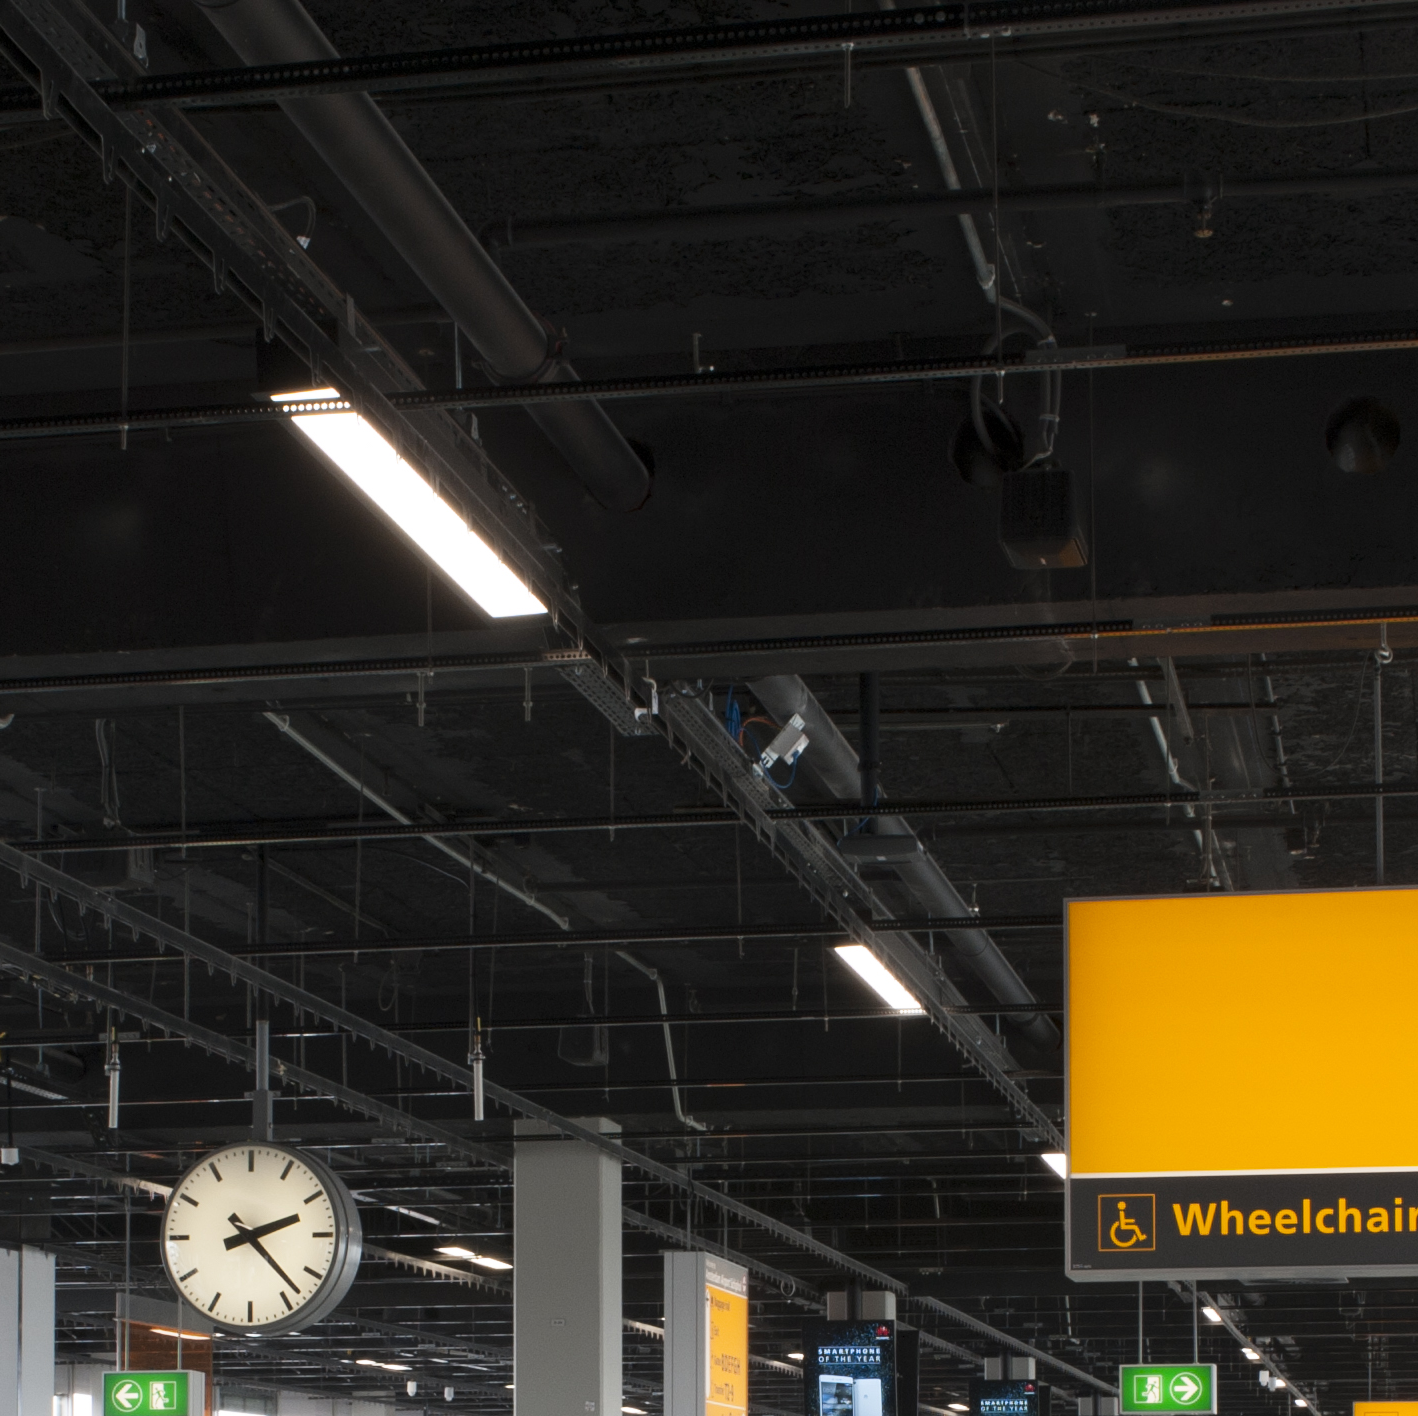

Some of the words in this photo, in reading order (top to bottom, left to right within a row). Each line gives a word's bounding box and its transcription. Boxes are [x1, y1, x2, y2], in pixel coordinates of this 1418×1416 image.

[818, 1355, 830, 1363] OF
[835, 1355, 852, 1363] THE
[857, 1355, 881, 1363] YEAR
